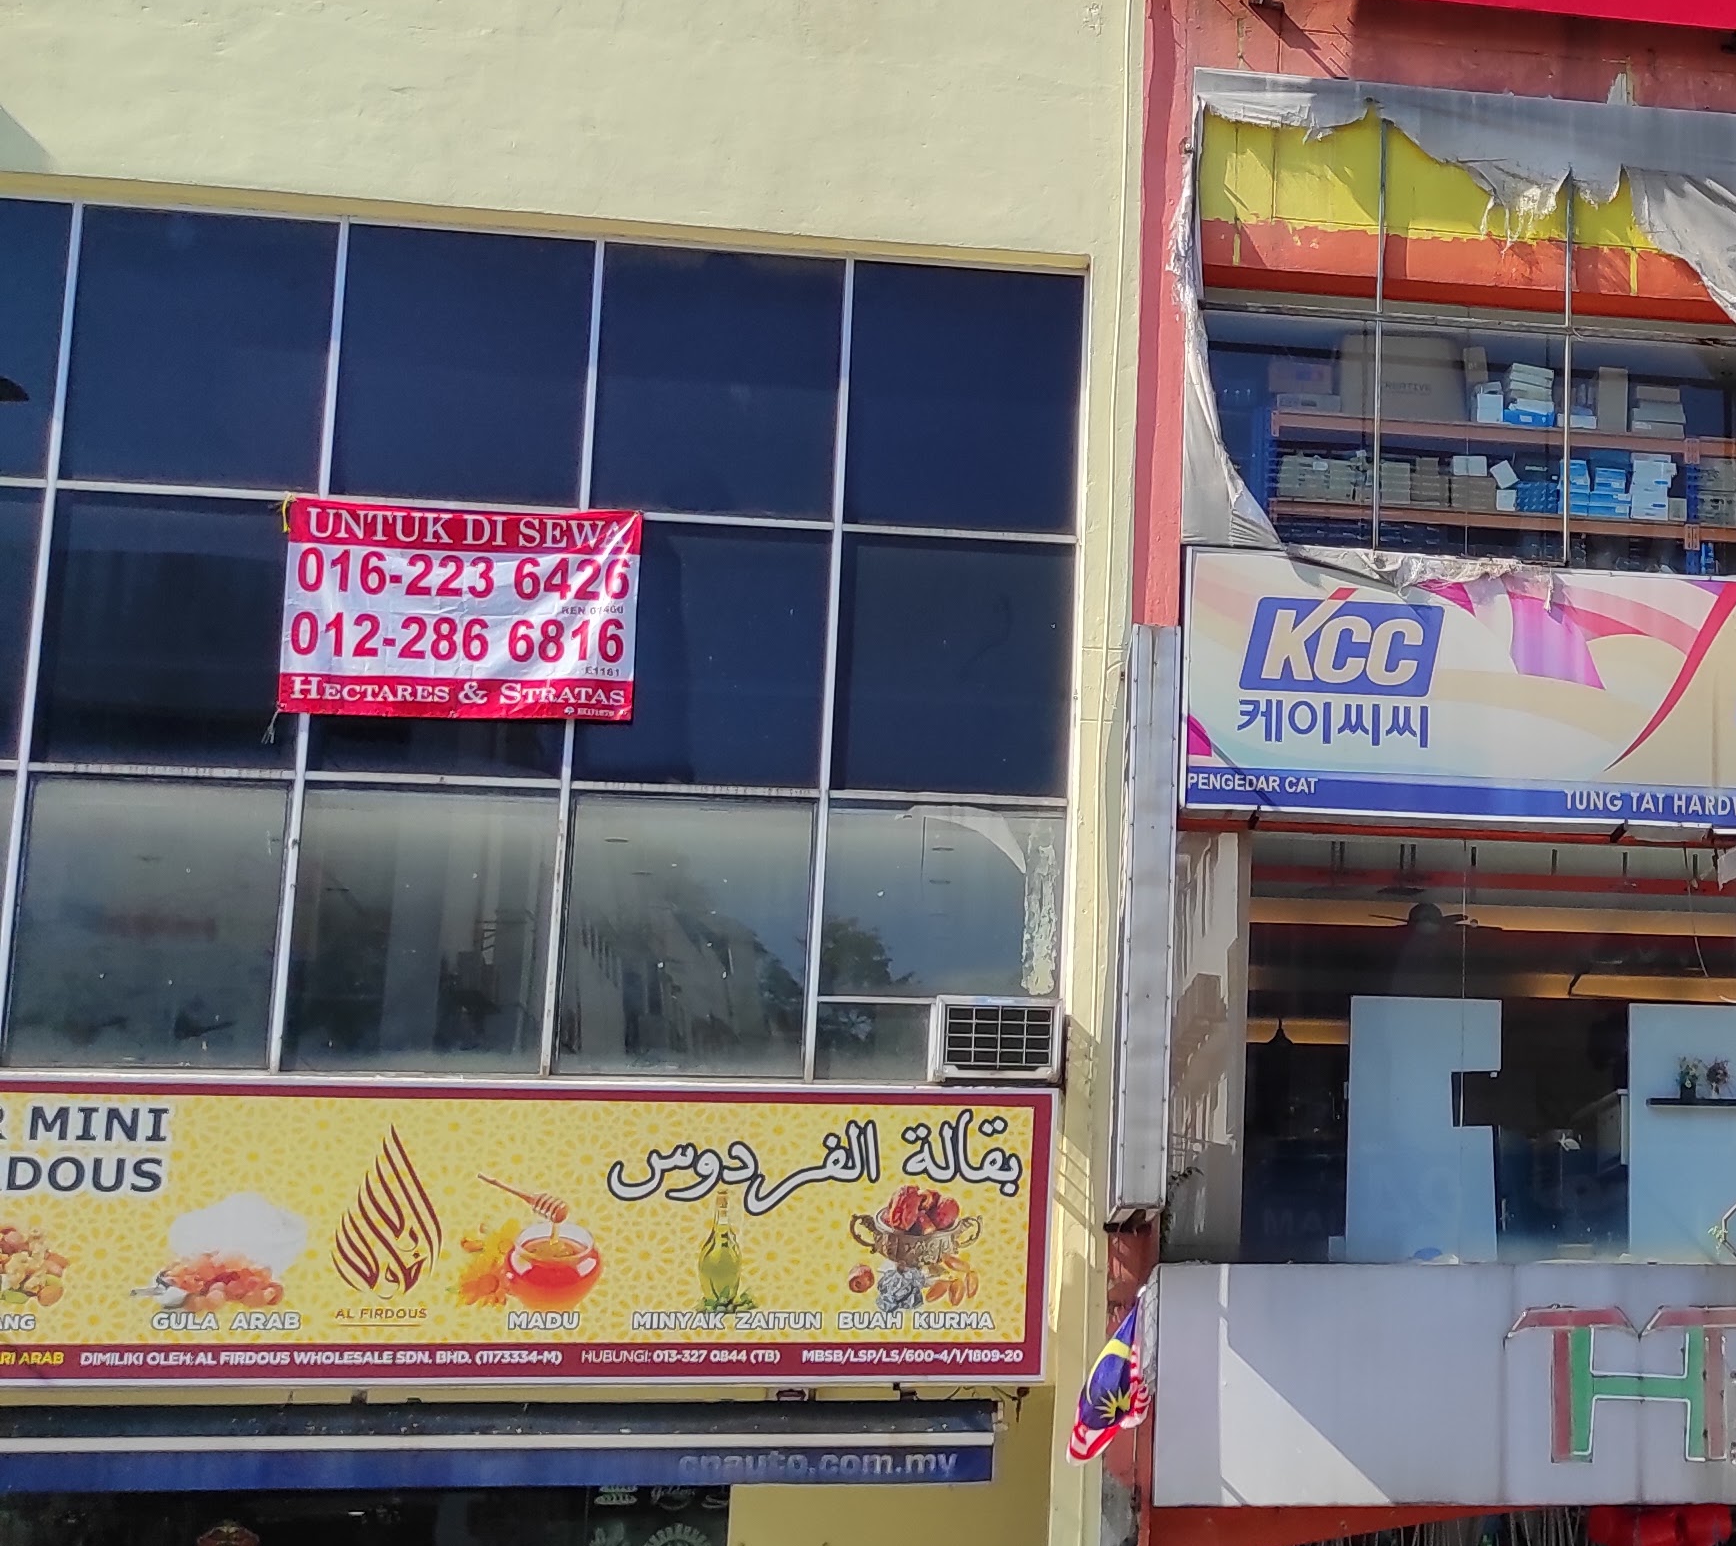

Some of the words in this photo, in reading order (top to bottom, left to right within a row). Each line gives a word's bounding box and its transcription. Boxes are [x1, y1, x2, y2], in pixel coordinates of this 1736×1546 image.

[306, 507, 453, 545] UNTUK
[462, 514, 507, 546] DI
[518, 519, 626, 549] SEWA
[298, 546, 495, 599] 016-223
[513, 555, 631, 601] 6426
[290, 610, 489, 662] 012-286
[507, 617, 626, 664] 6816
[1261, 587, 1424, 685] KCC
[289, 675, 450, 705] HECTARES
[458, 680, 488, 705] &
[499, 682, 626, 707] STRATAS
[1237, 698, 1430, 749] 케이씨씨
[1187, 772, 1281, 794] PENGEDAR
[1285, 775, 1318, 795] CAT
[1630, 791, 1666, 814] TAT
[29, 1105, 170, 1143] MINI
[607, 1119, 881, 1216] الفردوس
[901, 1109, 1022, 1197] بقالة
[0, 1156, 164, 1193] DOUS
[151, 1311, 218, 1332] GULA
[230, 1311, 301, 1332] ARAB
[507, 1310, 580, 1331] MADU
[631, 1310, 726, 1331] MINYAK
[735, 1310, 823, 1330] ZAITUN
[837, 1310, 903, 1331] BUAH
[912, 1310, 995, 1331] KURMA
[335, 1308, 356, 1320] AL
[360, 1308, 428, 1321] FIRDOUS
[19, 1351, 64, 1365] ARAB
[80, 1351, 144, 1366] DIMILIKI
[219, 1351, 292, 1366] FIRDOUS
[294, 1351, 393, 1366] WHOLESALE
[396, 1350, 433, 1365] SDN.
[436, 1350, 472, 1365] BHD.
[475, 1350, 563, 1366] (1173334-M)
[653, 1349, 707, 1363] 013-327
[709, 1349, 748, 1364] 0844
